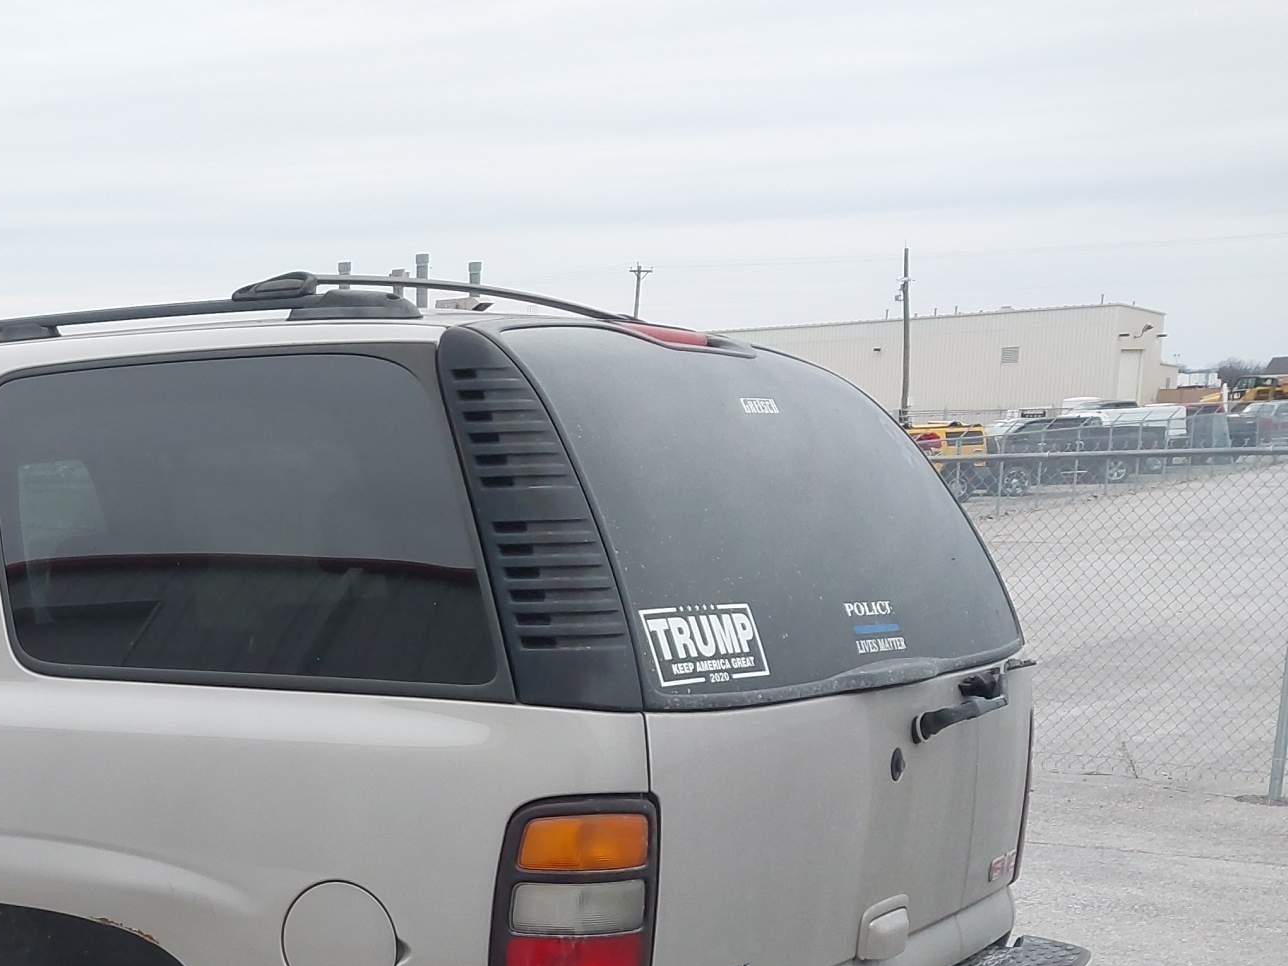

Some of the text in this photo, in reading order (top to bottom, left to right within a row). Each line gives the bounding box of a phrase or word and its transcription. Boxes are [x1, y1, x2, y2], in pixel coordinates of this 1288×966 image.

[646, 612, 754, 661] TRUMP
[855, 636, 907, 654] LIVES MATTER
[672, 656, 755, 675] KEEP AMERICA GREAT
[709, 671, 730, 683] 2020
